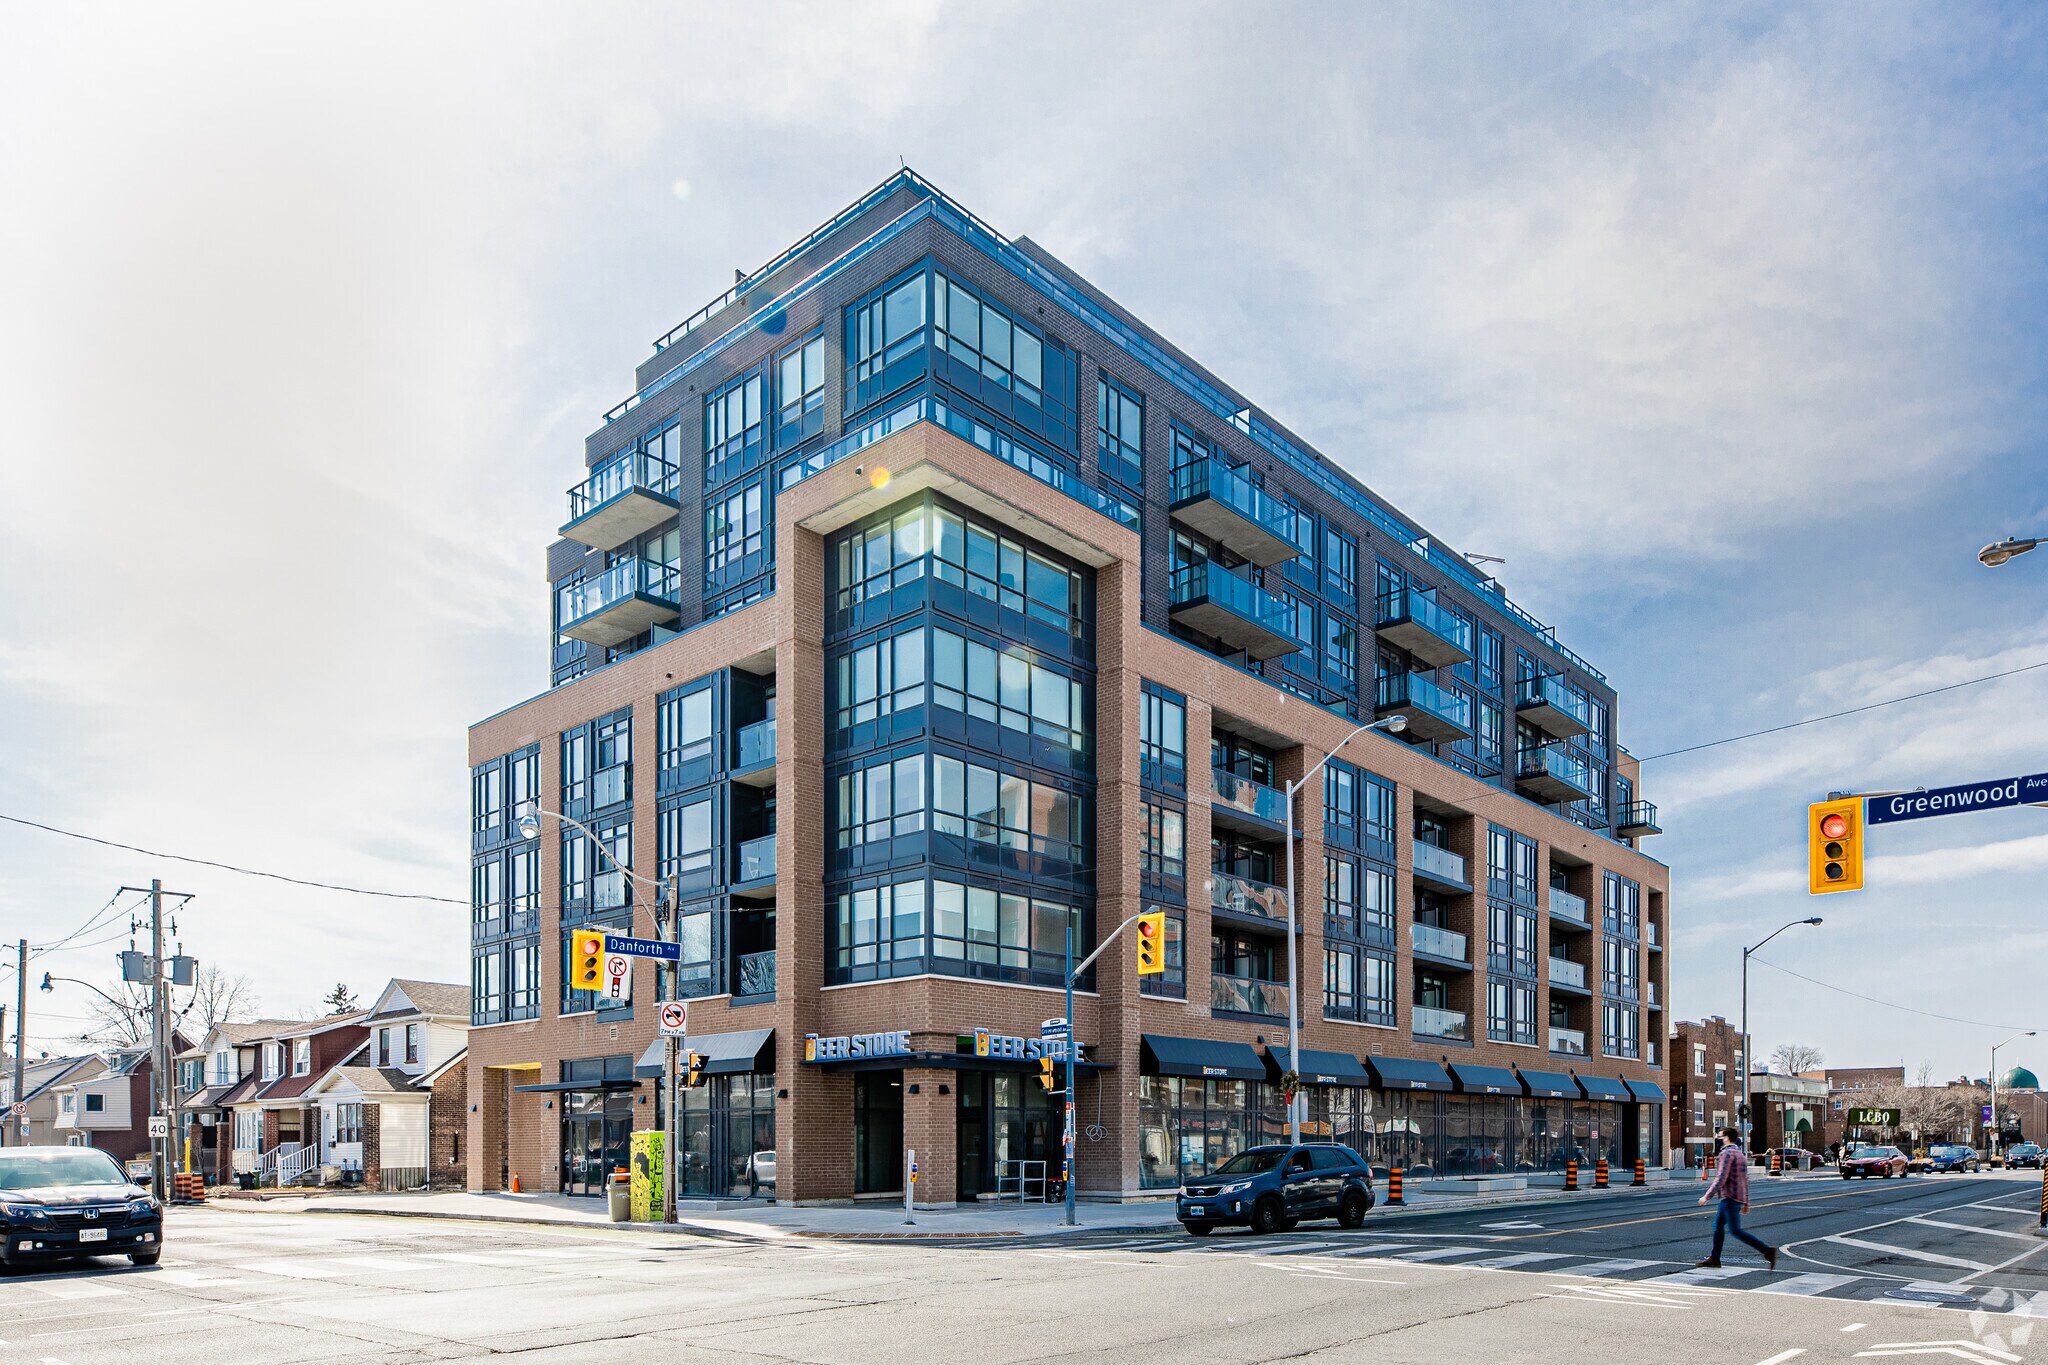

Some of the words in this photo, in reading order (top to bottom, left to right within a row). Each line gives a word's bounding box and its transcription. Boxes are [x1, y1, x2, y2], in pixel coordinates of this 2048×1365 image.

[1890, 780, 2019, 815] Greenwood
[2026, 778, 2048, 788] Ave
[610, 939, 663, 955] Danforth
[805, 1033, 850, 1060] BEER
[851, 1030, 911, 1057] STORE
[974, 1028, 1025, 1059] BEER
[1859, 1111, 1890, 1123] LCBO
[151, 1125, 166, 1134] 40
